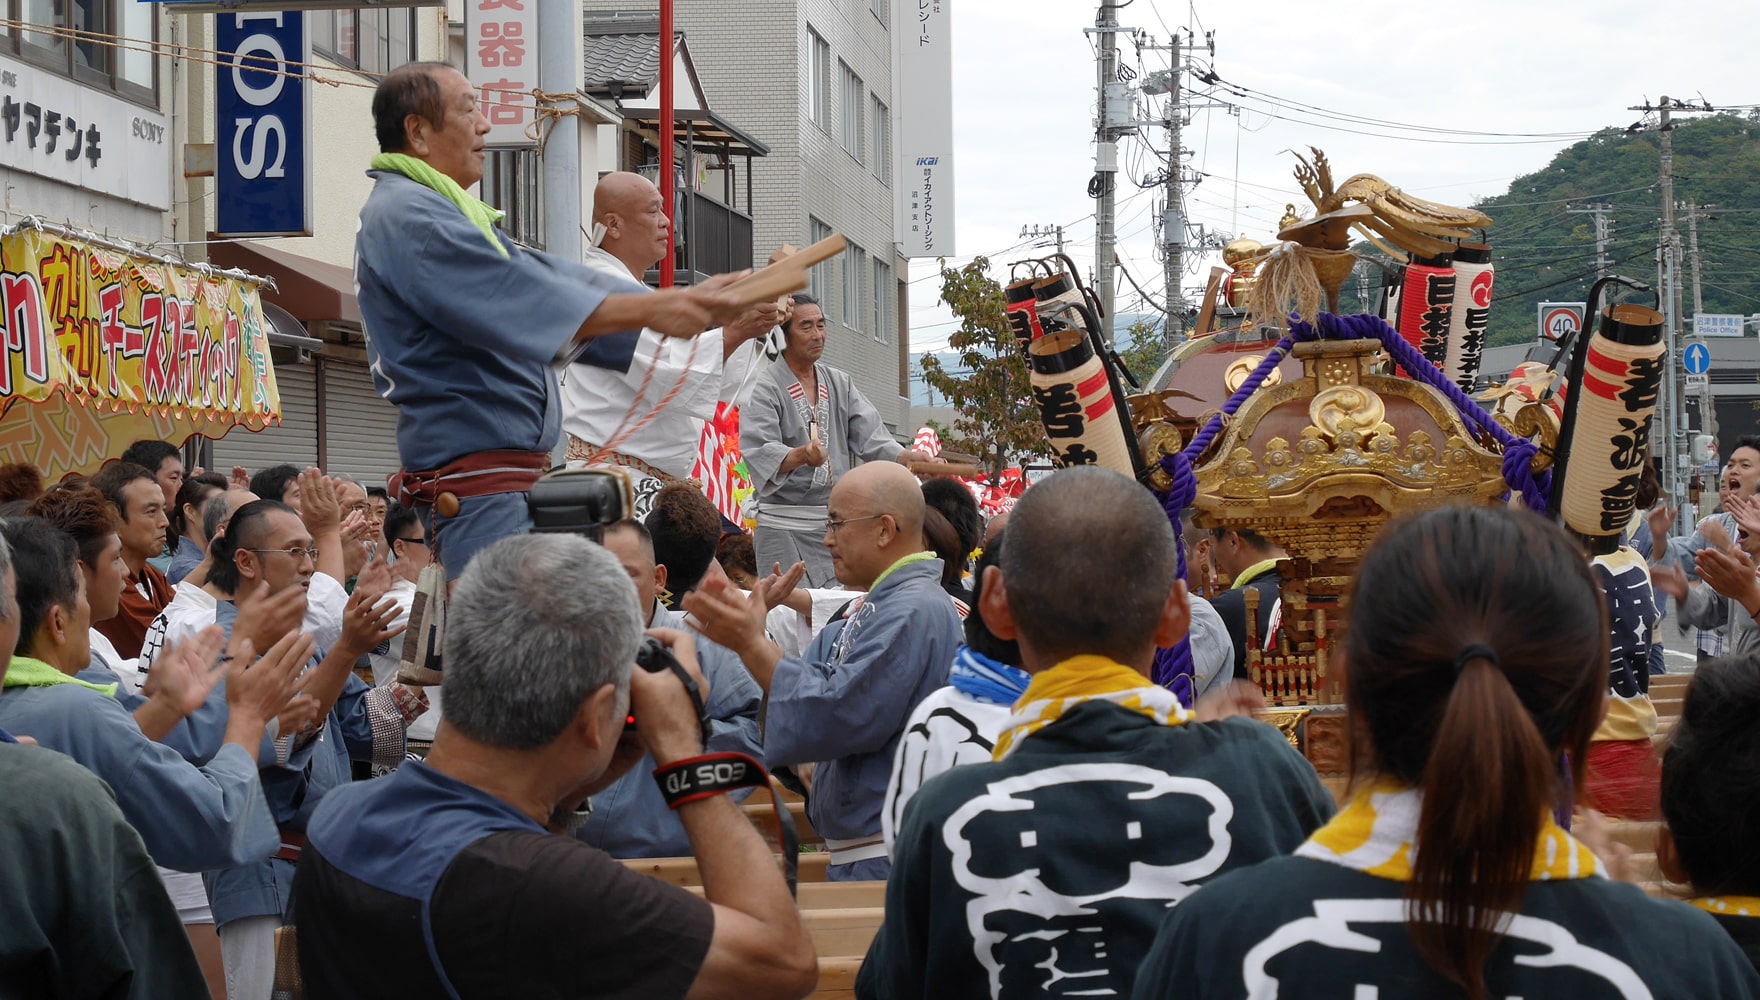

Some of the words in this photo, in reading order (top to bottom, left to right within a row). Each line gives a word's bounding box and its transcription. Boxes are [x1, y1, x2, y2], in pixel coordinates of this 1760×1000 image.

[132, 116, 165, 145] SONY
[1553, 318, 1573, 334] 40
[100, 283, 242, 412] チーズスティック
[666, 769, 692, 794] 7D
[696, 762, 747, 785] EOS
